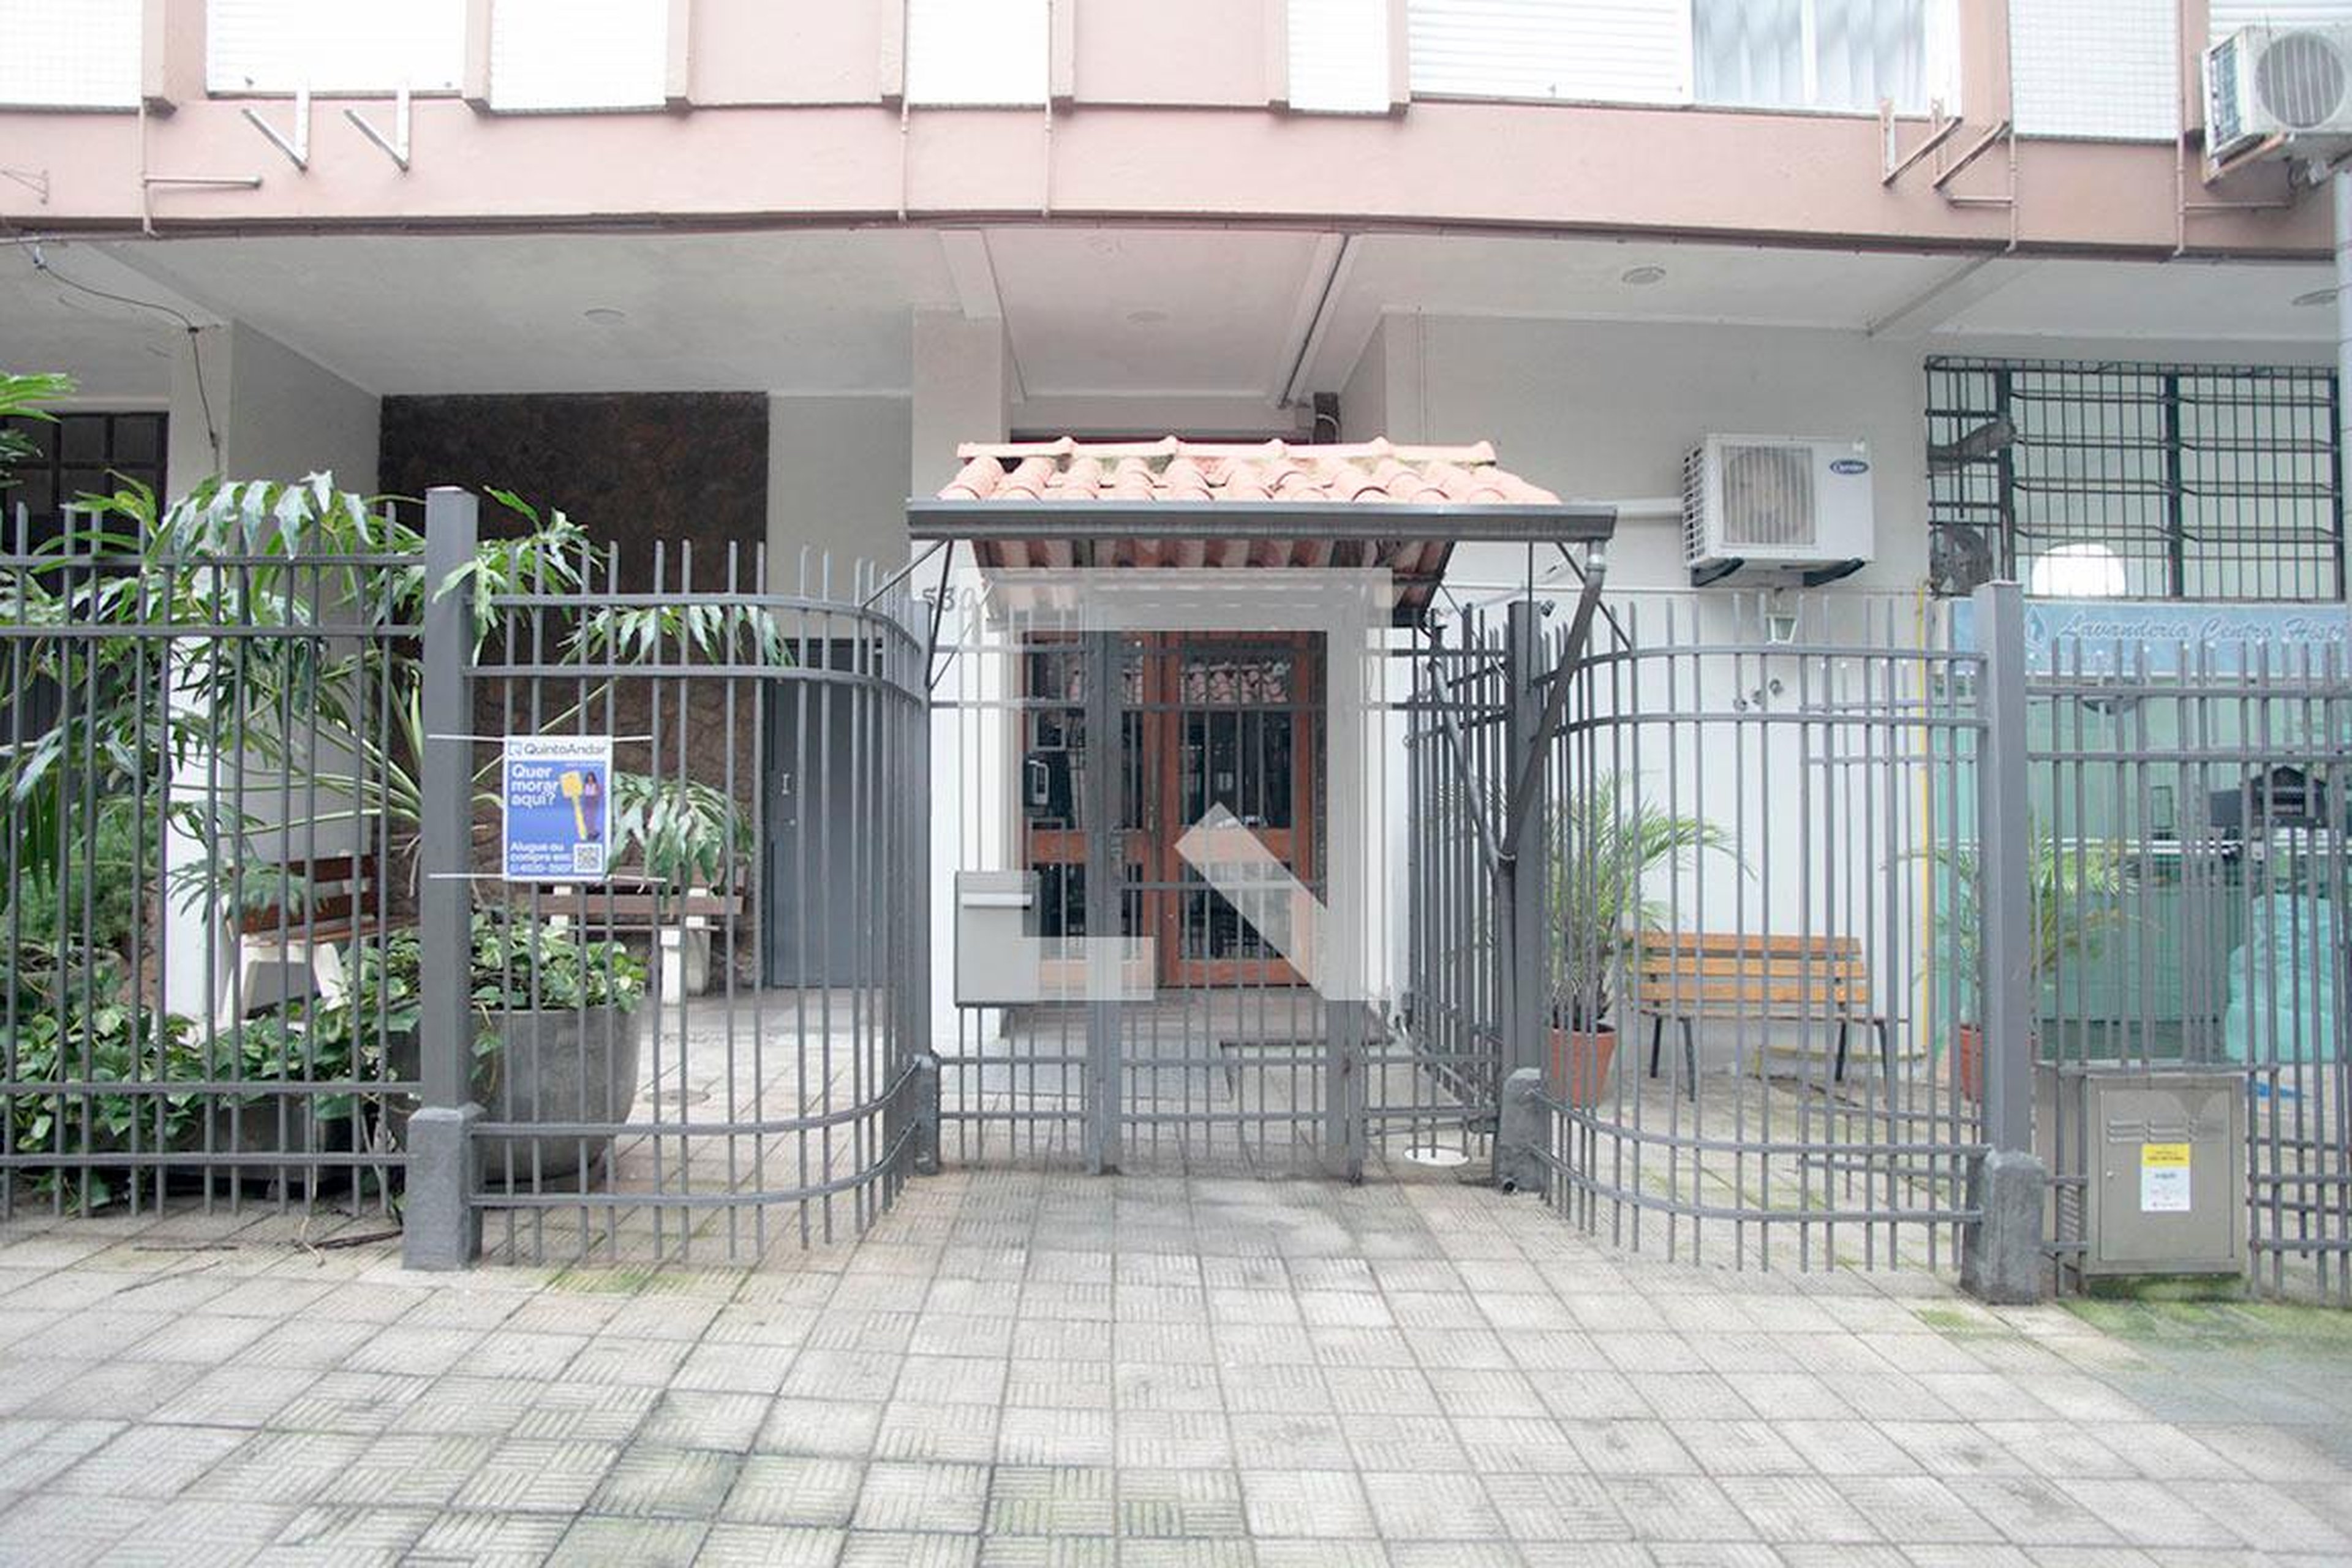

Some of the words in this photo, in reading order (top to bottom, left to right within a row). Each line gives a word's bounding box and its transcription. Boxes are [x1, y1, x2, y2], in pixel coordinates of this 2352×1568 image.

[2057, 610, 2190, 638] Lavanderia
[2199, 616, 2272, 640] Centro
[524, 742, 607, 755] QuintoAndar
[512, 764, 552, 777] Quer
[511, 780, 558, 793] morar
[511, 793, 556, 808] aqui?
